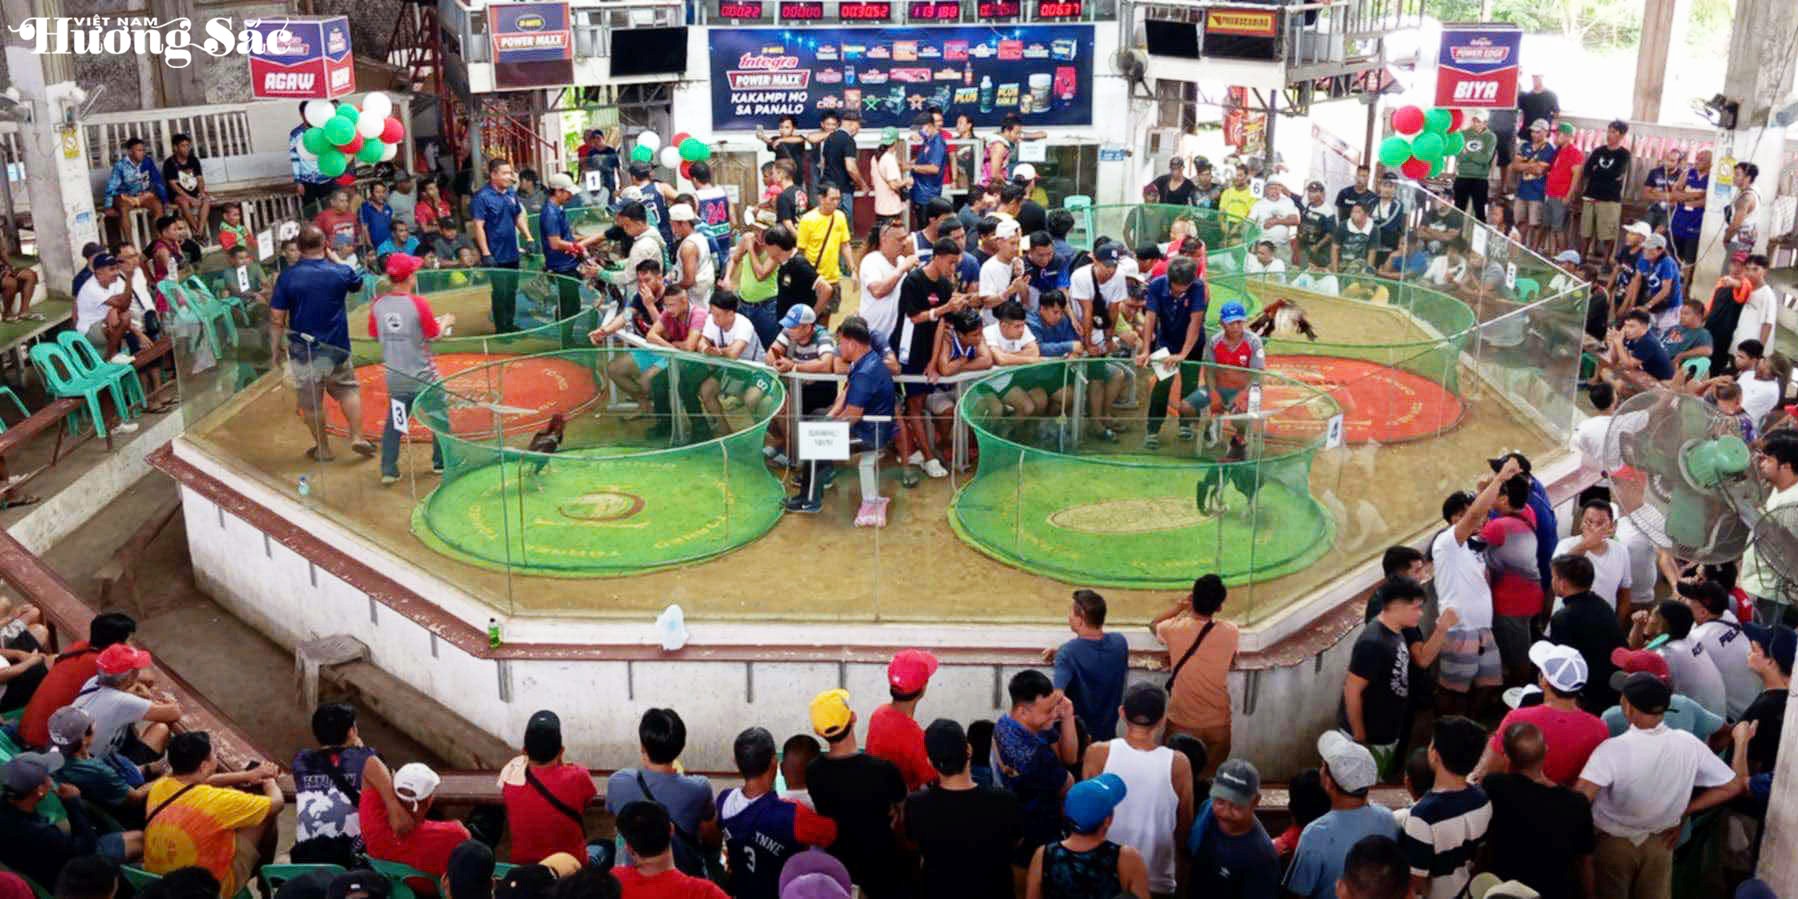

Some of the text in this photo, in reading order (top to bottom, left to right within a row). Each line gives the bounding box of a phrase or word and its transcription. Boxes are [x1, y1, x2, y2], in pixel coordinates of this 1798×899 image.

[738, 52, 799, 72] Integra
[264, 73, 315, 90] AGAW
[735, 75, 770, 87] POWER
[731, 92, 786, 104] KAKAMPI
[788, 92, 808, 103] MO
[1453, 81, 1499, 99] BIYA
[736, 104, 804, 115] SA PANALO
[1253, 182, 1261, 194] 6
[707, 201, 727, 225] 24
[395, 406, 404, 425] 3
[743, 845, 757, 873] 3
